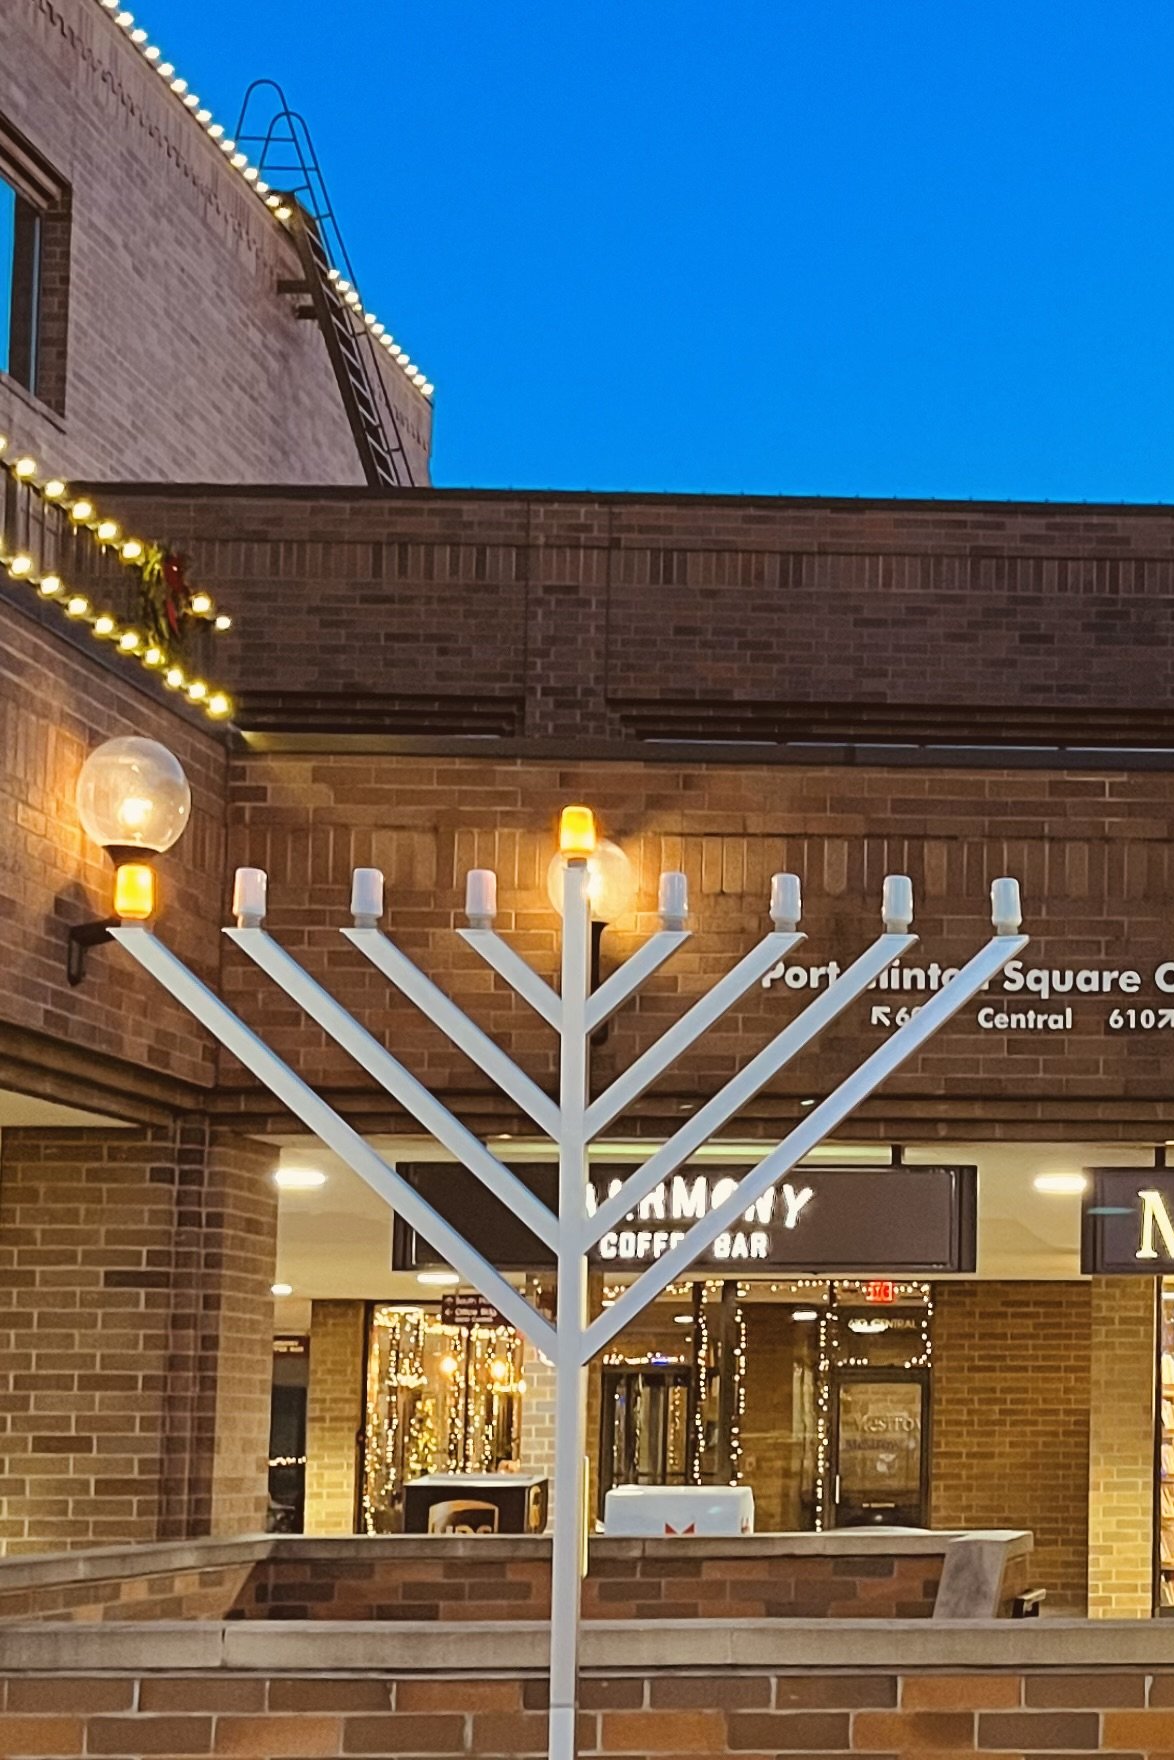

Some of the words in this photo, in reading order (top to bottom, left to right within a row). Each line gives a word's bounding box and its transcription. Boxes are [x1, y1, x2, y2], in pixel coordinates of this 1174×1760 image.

[761, 960, 840, 989] Port
[866, 959, 990, 990] linto
[1002, 960, 1142, 999] Square
[977, 1007, 1072, 1029] Central
[1109, 1009, 1155, 1029] 610
[713, 1232, 769, 1259] BAR
